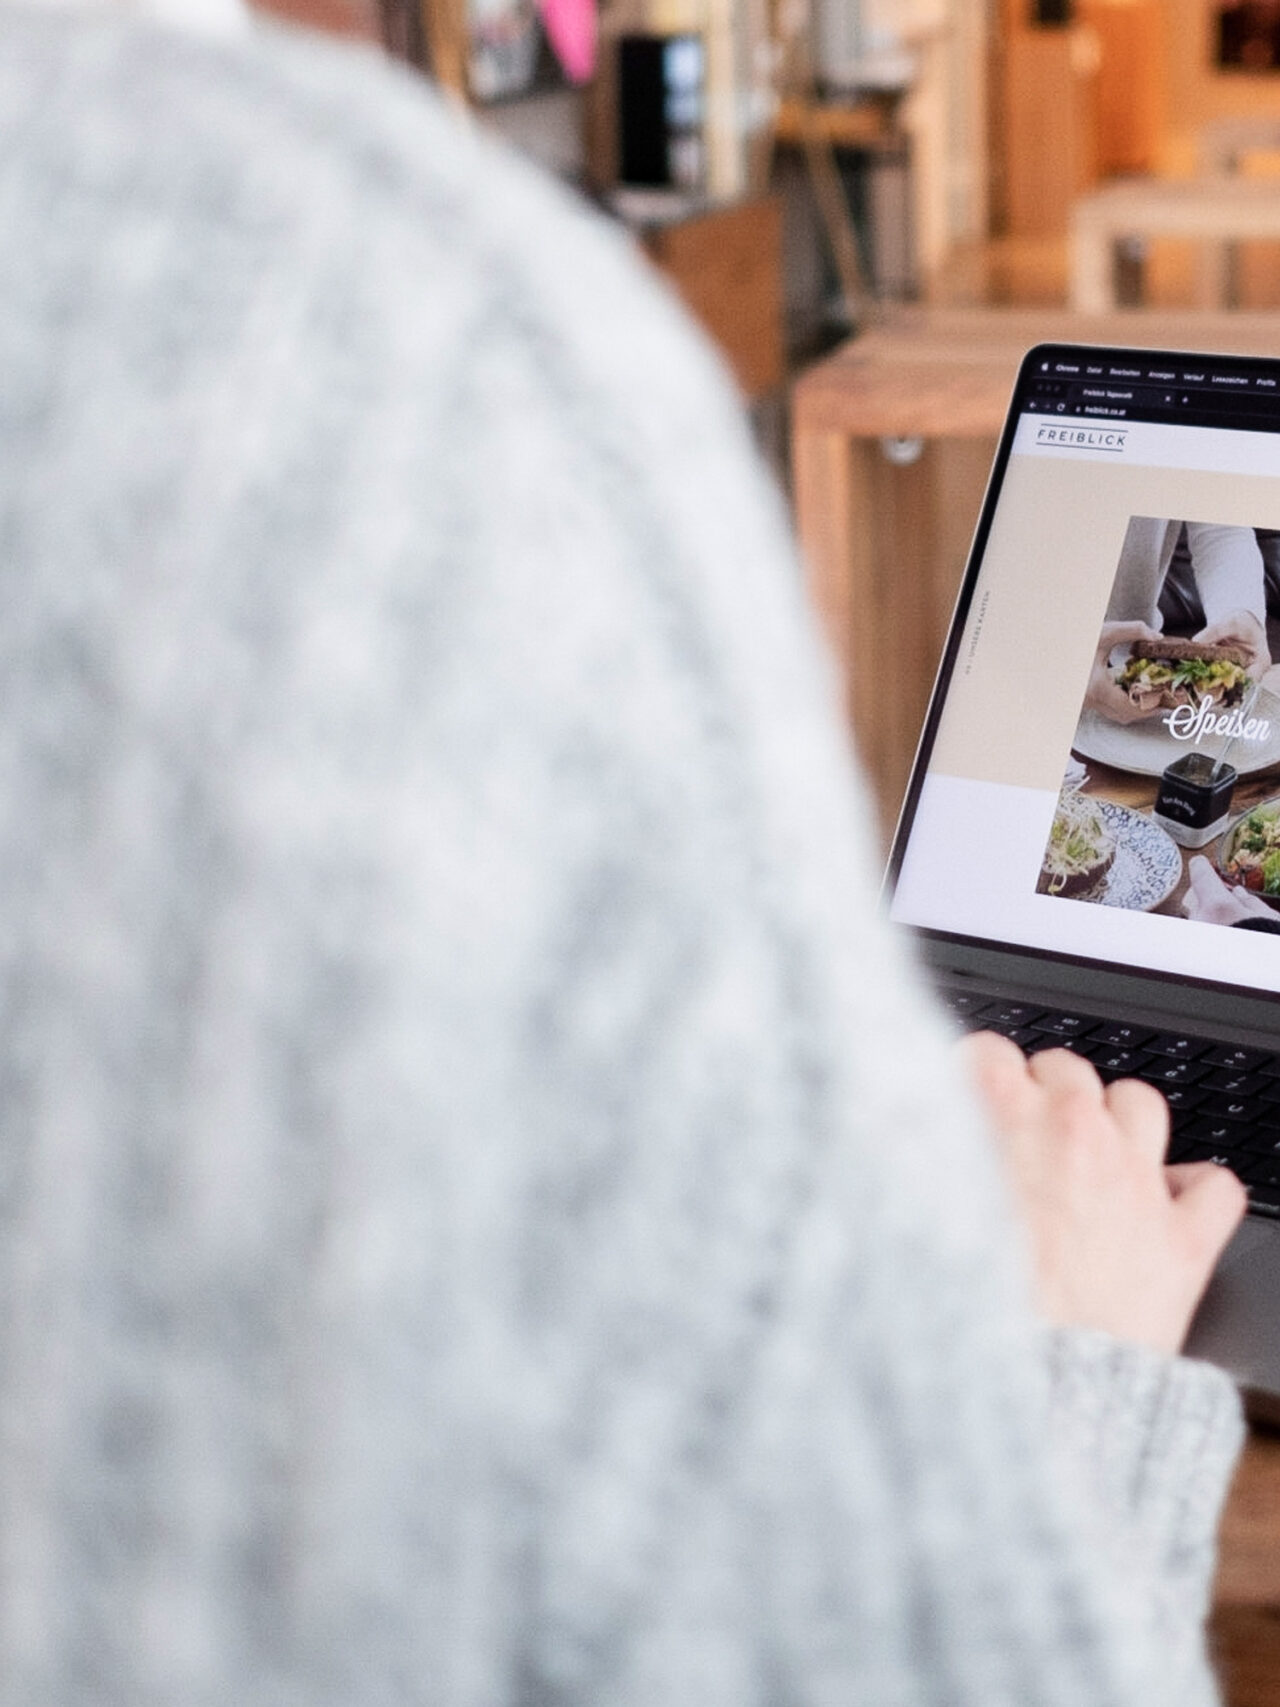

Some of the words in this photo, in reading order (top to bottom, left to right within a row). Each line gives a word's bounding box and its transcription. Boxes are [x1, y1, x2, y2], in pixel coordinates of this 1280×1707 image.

[1055, 364, 1080, 373] Chrome
[1212, 375, 1249, 385] Lesezeichen
[1037, 428, 1126, 446] FREIBLICK
[1162, 694, 1271, 744] Speisen
[1228, 1104, 1244, 1113] U
